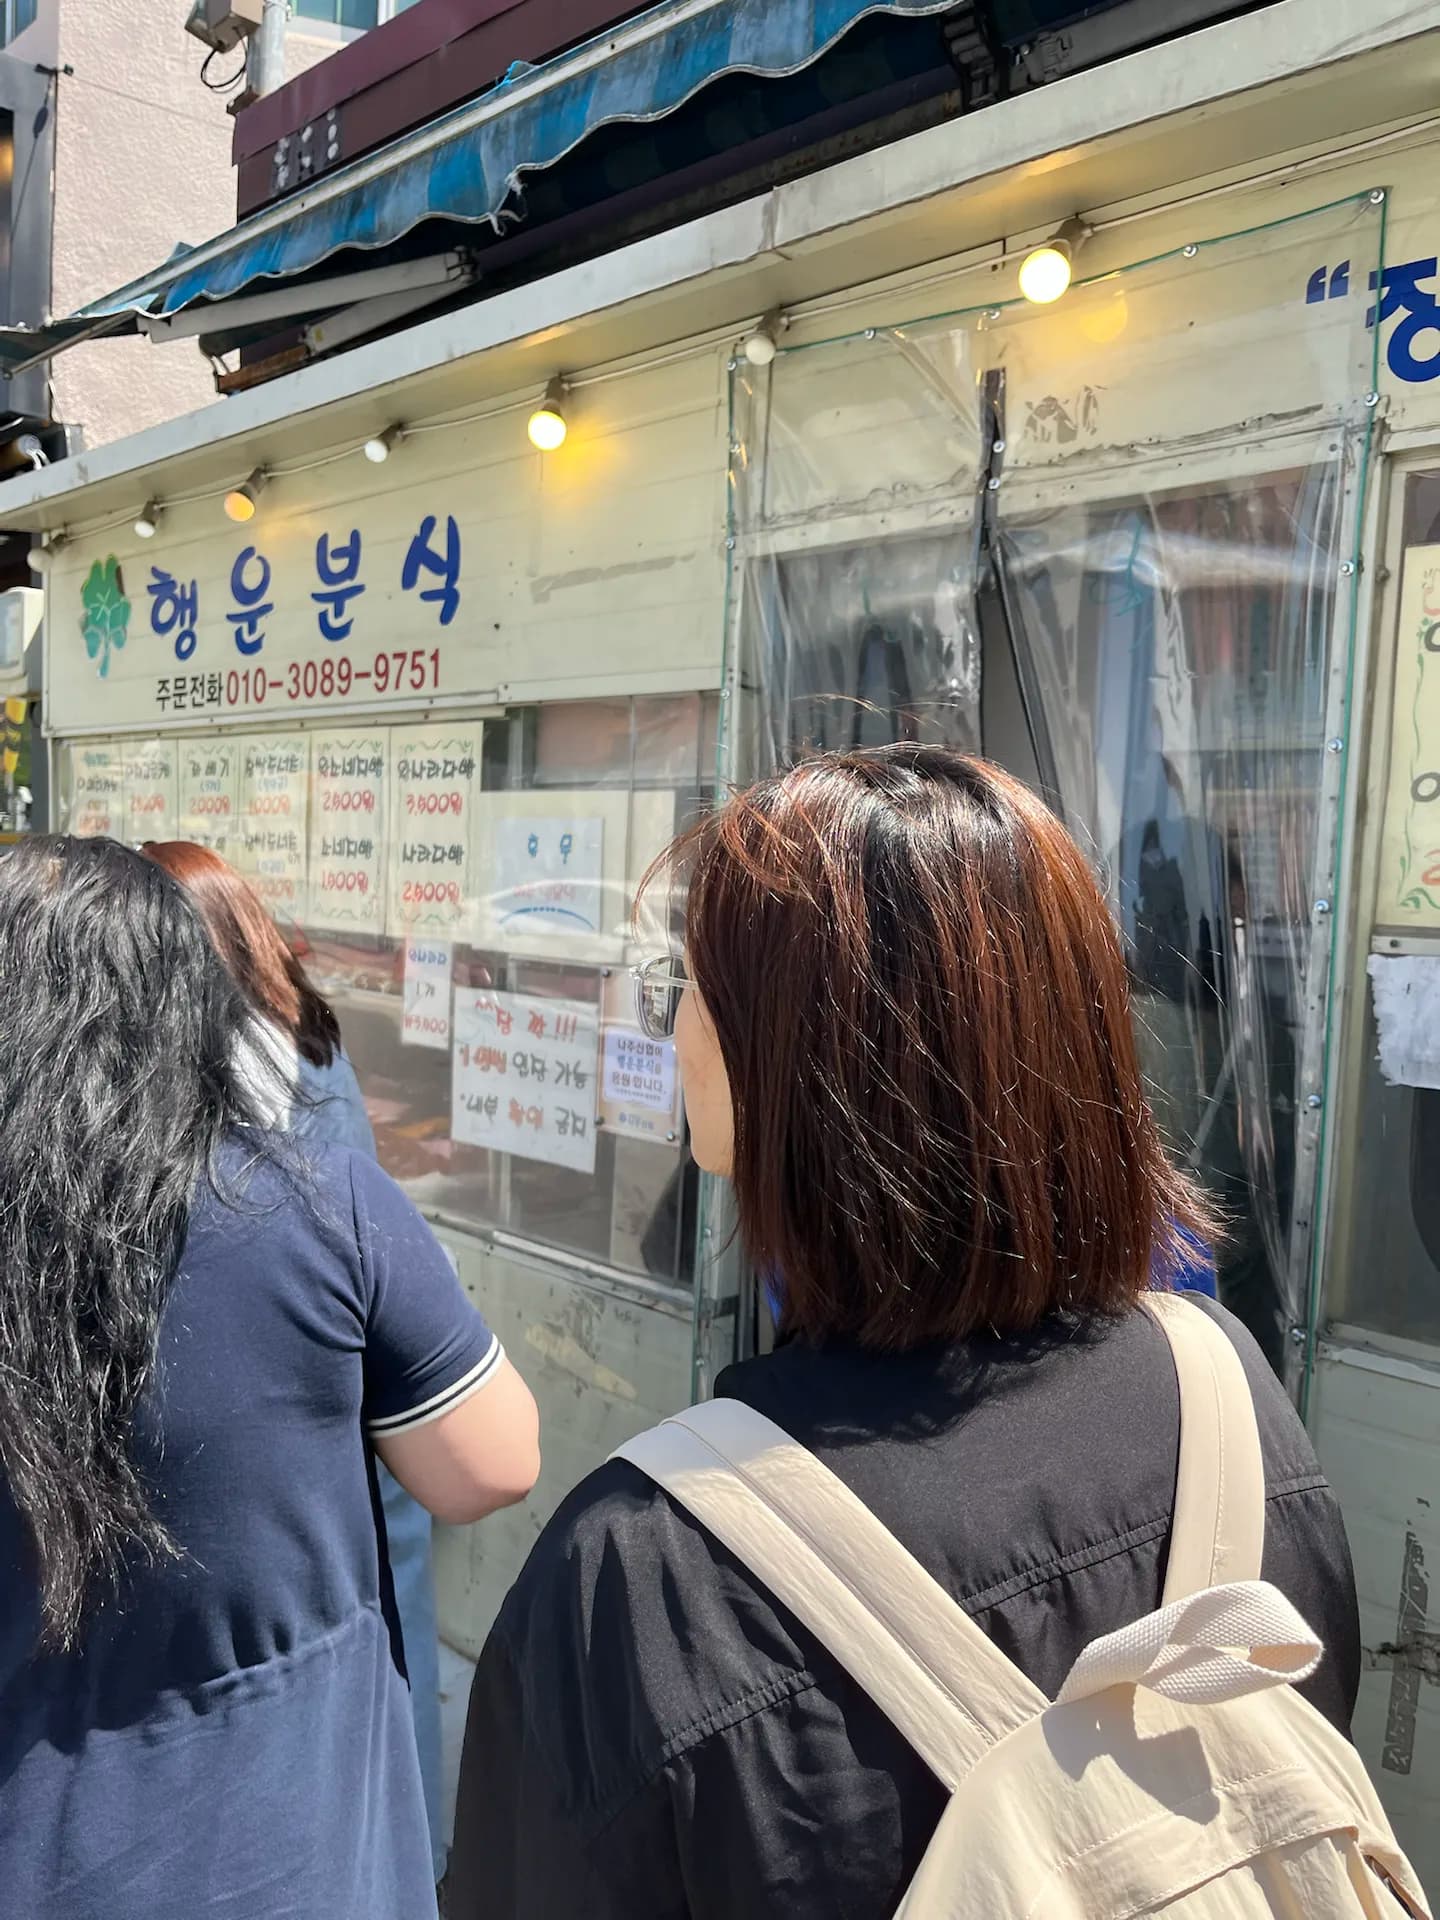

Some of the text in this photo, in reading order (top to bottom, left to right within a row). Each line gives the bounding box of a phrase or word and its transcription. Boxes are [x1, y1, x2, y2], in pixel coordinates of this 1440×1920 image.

[147, 515, 461, 661] 행운분식
[156, 648, 441, 711] 주문전화 010-3089-9751
